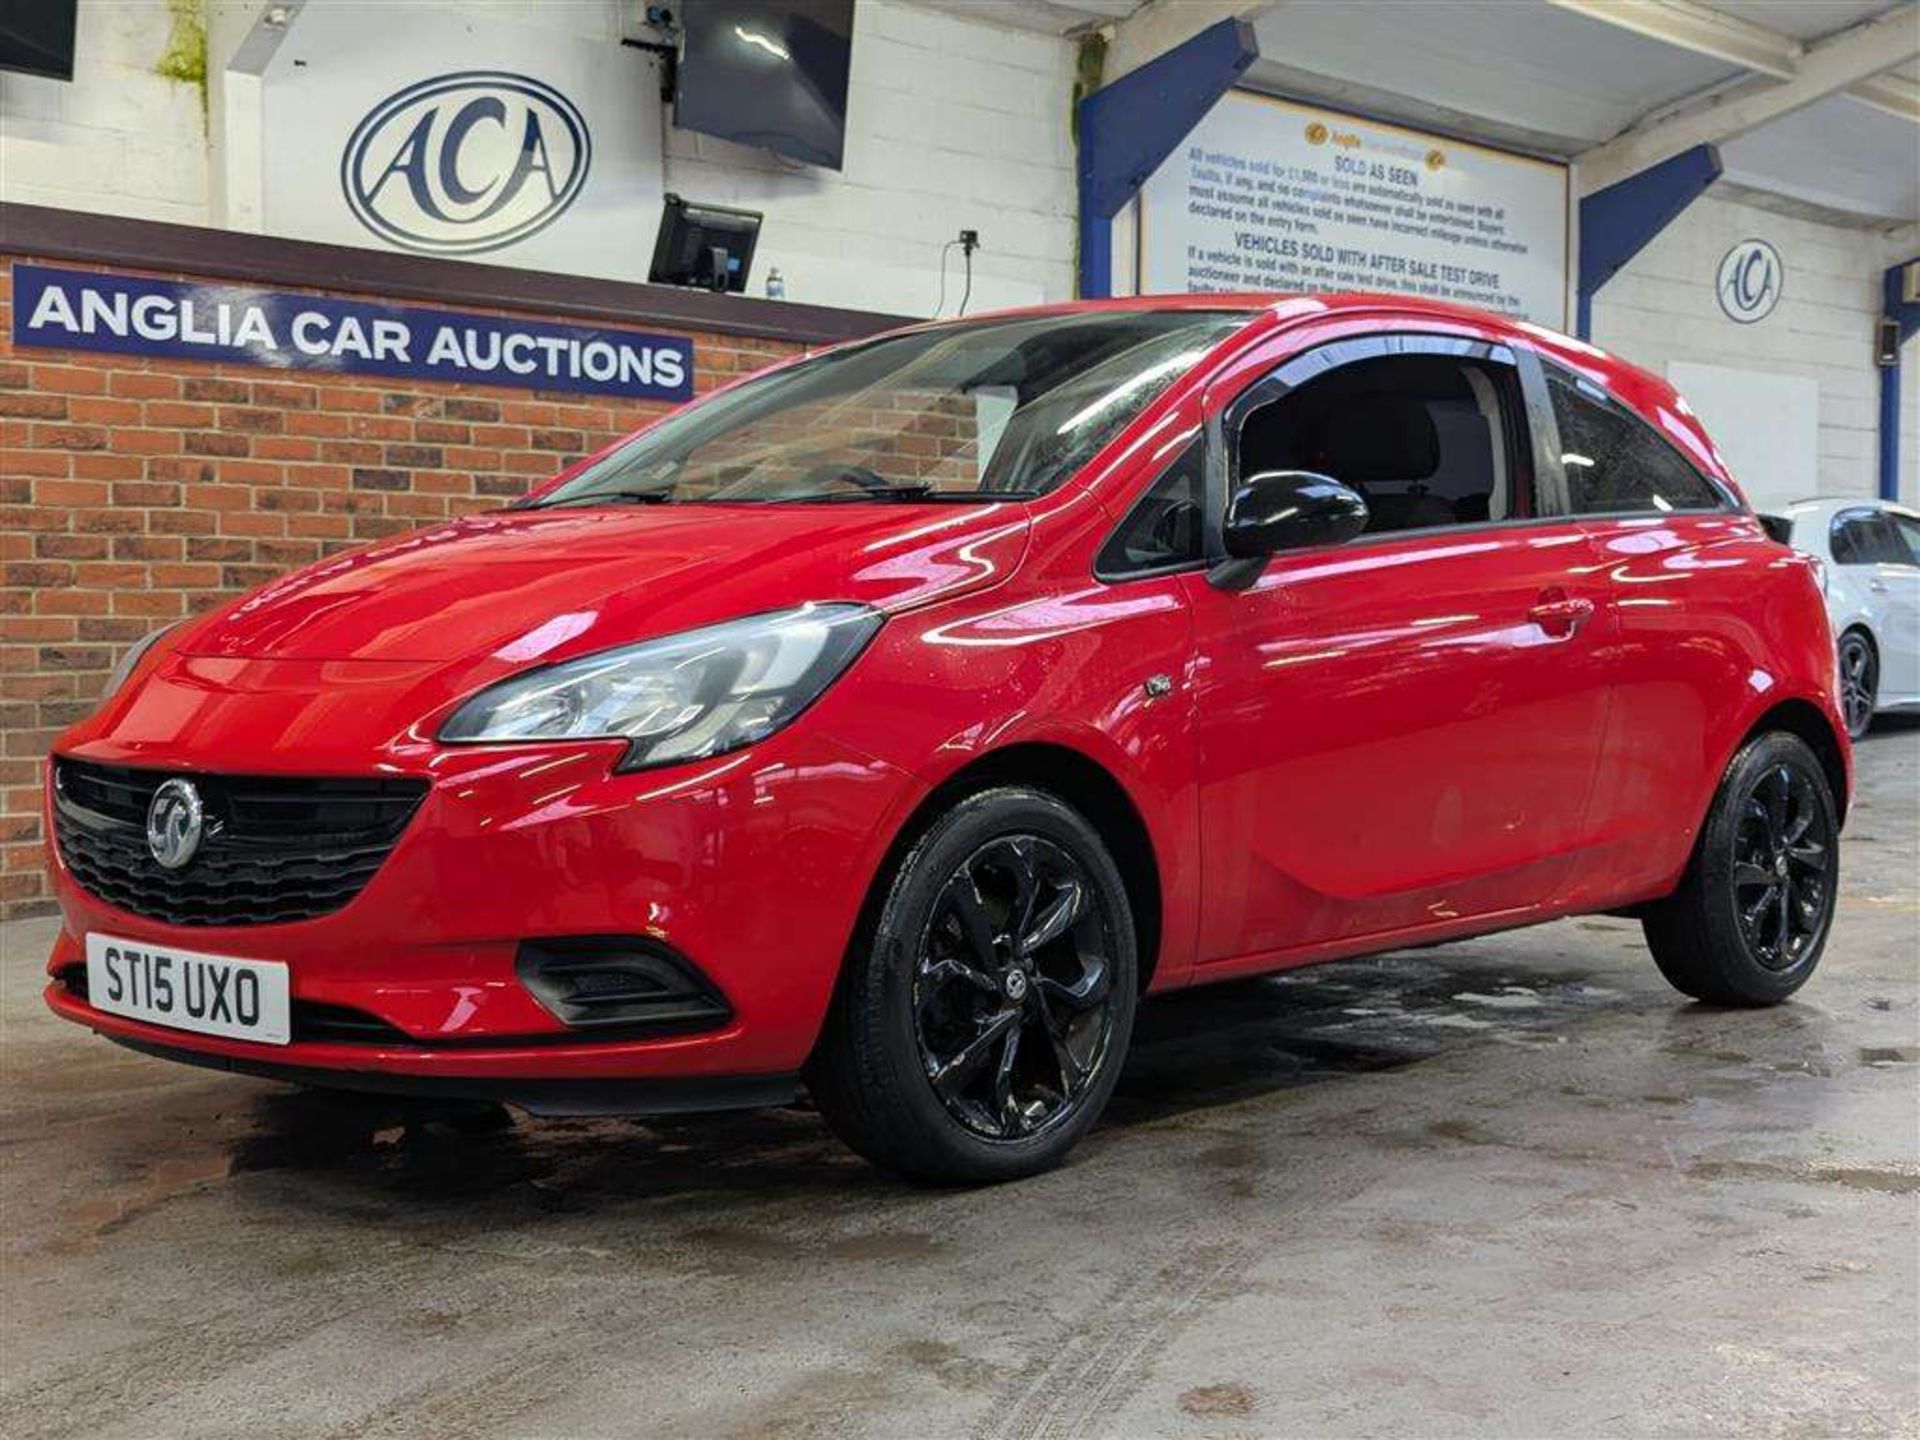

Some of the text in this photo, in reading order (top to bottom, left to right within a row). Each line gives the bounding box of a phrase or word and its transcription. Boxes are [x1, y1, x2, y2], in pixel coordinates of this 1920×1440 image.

[365, 97, 567, 225] ACA
[1205, 153, 1246, 171] vehicles
[1248, 160, 1270, 175] sold
[1334, 155, 1418, 187] SOLD AS SEEN
[1188, 185, 1215, 200] must
[1271, 199, 1311, 217] vehicles
[1188, 200, 1233, 220] declared
[1187, 265, 1241, 284] auctioneer
[1206, 251, 1242, 267] vehicle
[1234, 231, 1500, 291] VEHICLES SOLD WITH AFTER SALE TEST DRIVE
[28, 284, 685, 390] ANGLIA CAR AUCTIONS
[105, 946, 260, 1027] ST15 UXO
